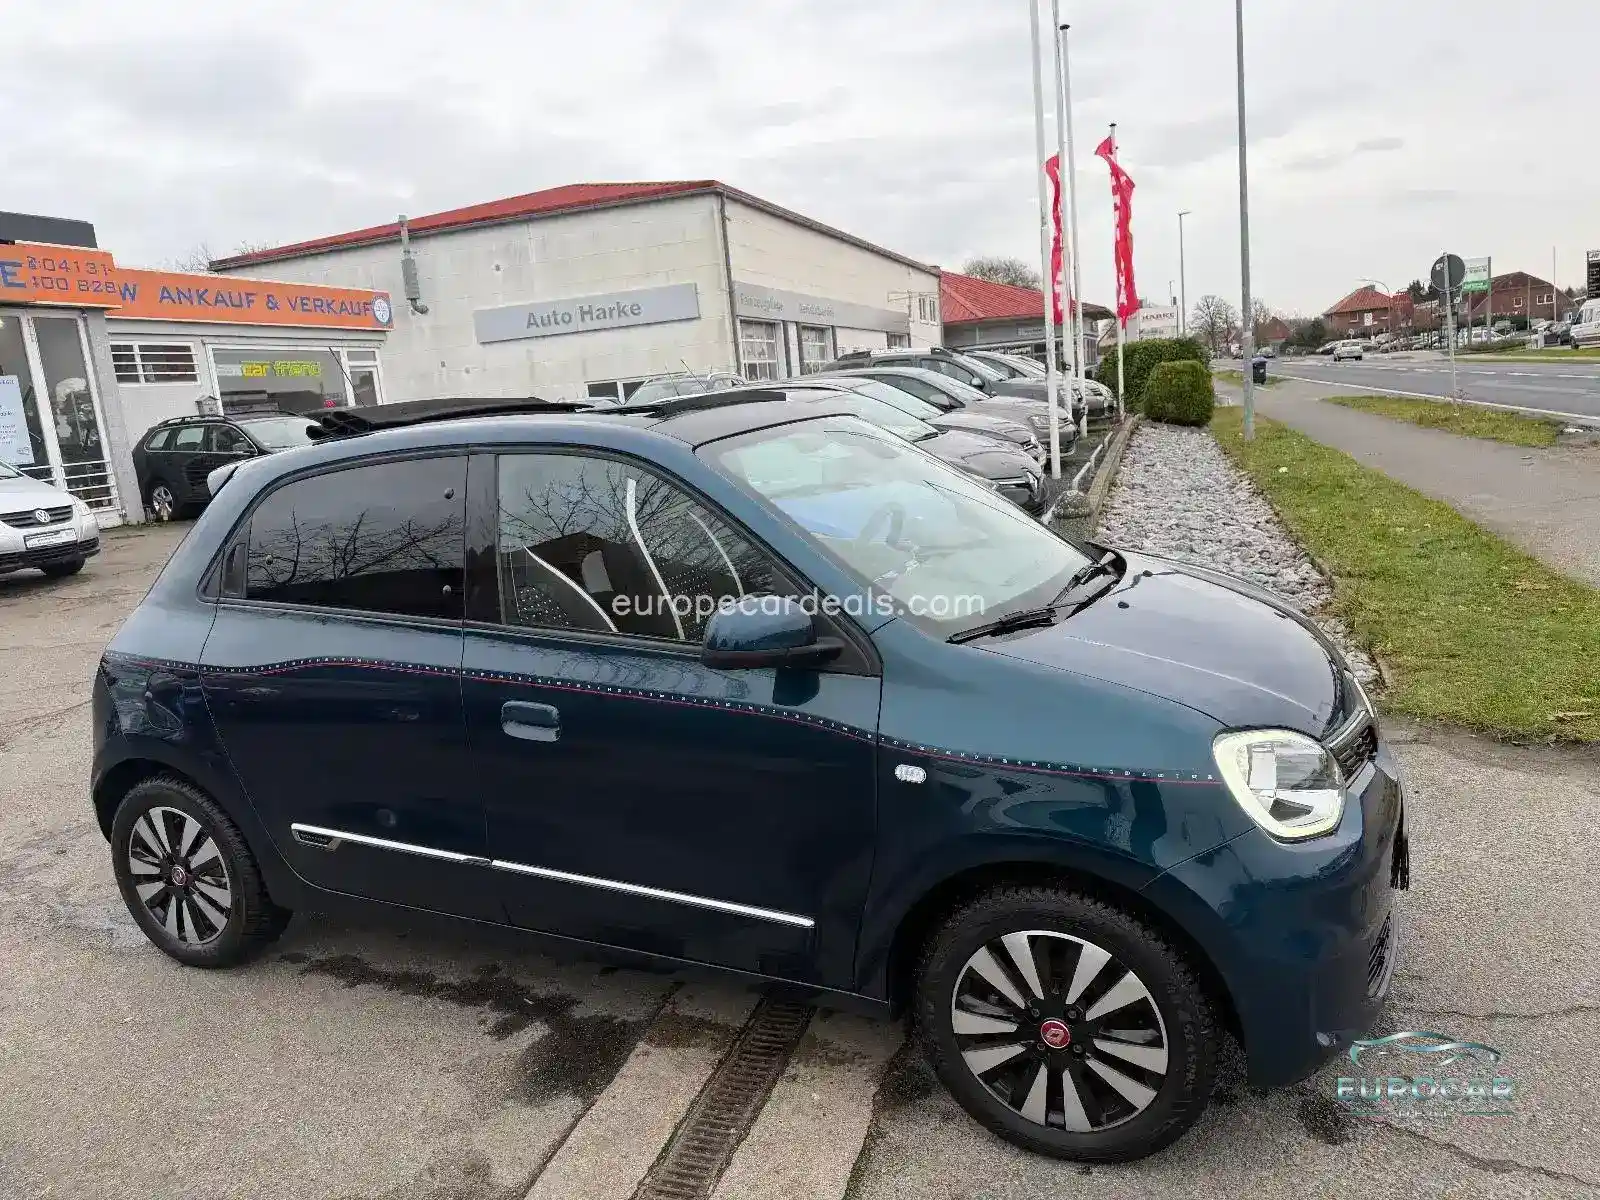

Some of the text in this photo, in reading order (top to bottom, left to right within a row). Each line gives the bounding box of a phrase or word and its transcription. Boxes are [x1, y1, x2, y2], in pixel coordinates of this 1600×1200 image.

[159, 285, 257, 309] ANKAUF
[266, 293, 281, 311] &
[286, 296, 374, 317] VERKAUF
[526, 302, 642, 329] Auto Harke
